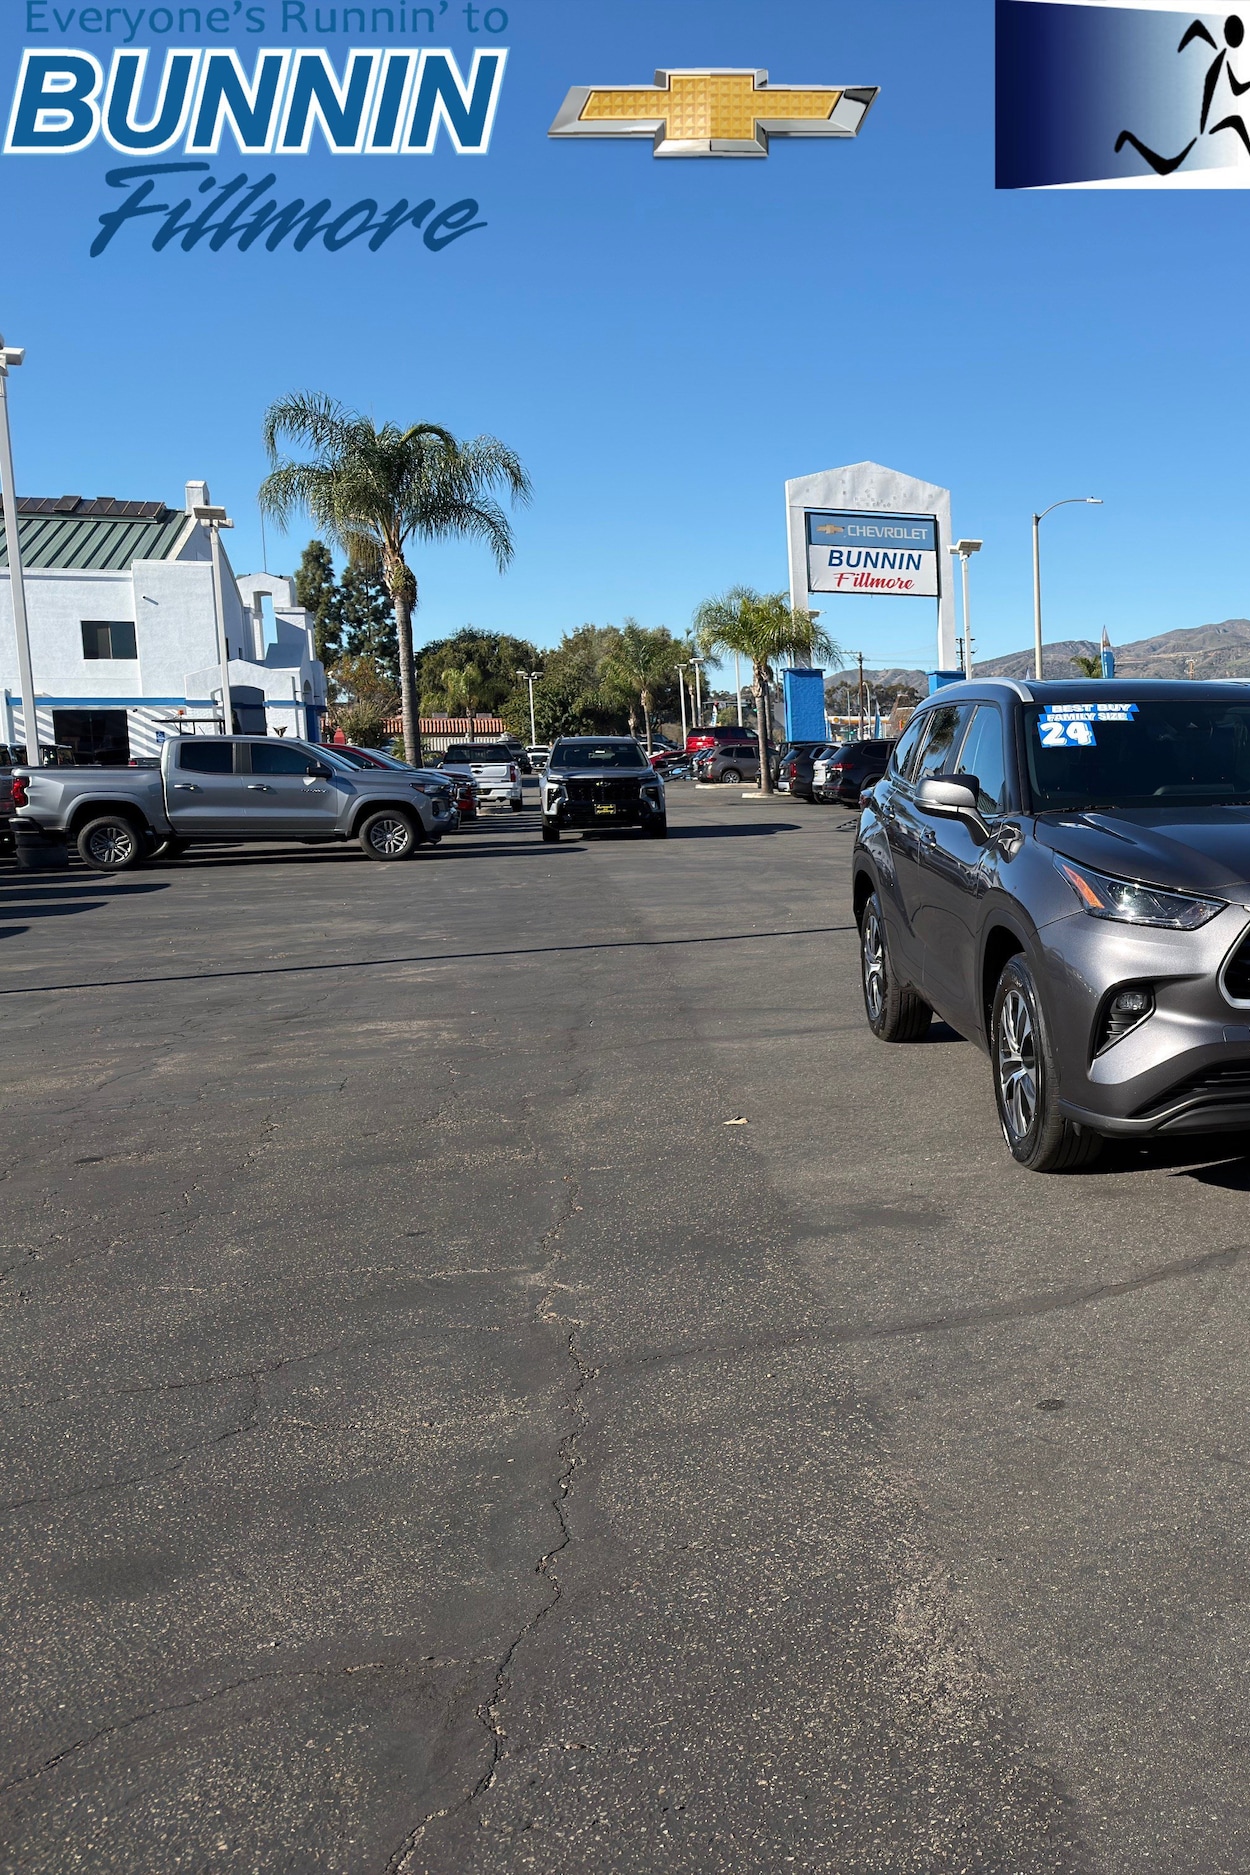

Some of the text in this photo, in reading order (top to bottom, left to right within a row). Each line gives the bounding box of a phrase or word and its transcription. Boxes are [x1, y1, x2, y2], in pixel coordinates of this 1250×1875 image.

[847, 524, 928, 540] CHEVROLET
[828, 549, 922, 571] BUNNIN
[834, 571, 915, 590] Fillmore
[1046, 712, 1128, 721] FAMILY SIZE
[1051, 703, 1132, 713] BEST BUY
[1040, 721, 1092, 746] 24
